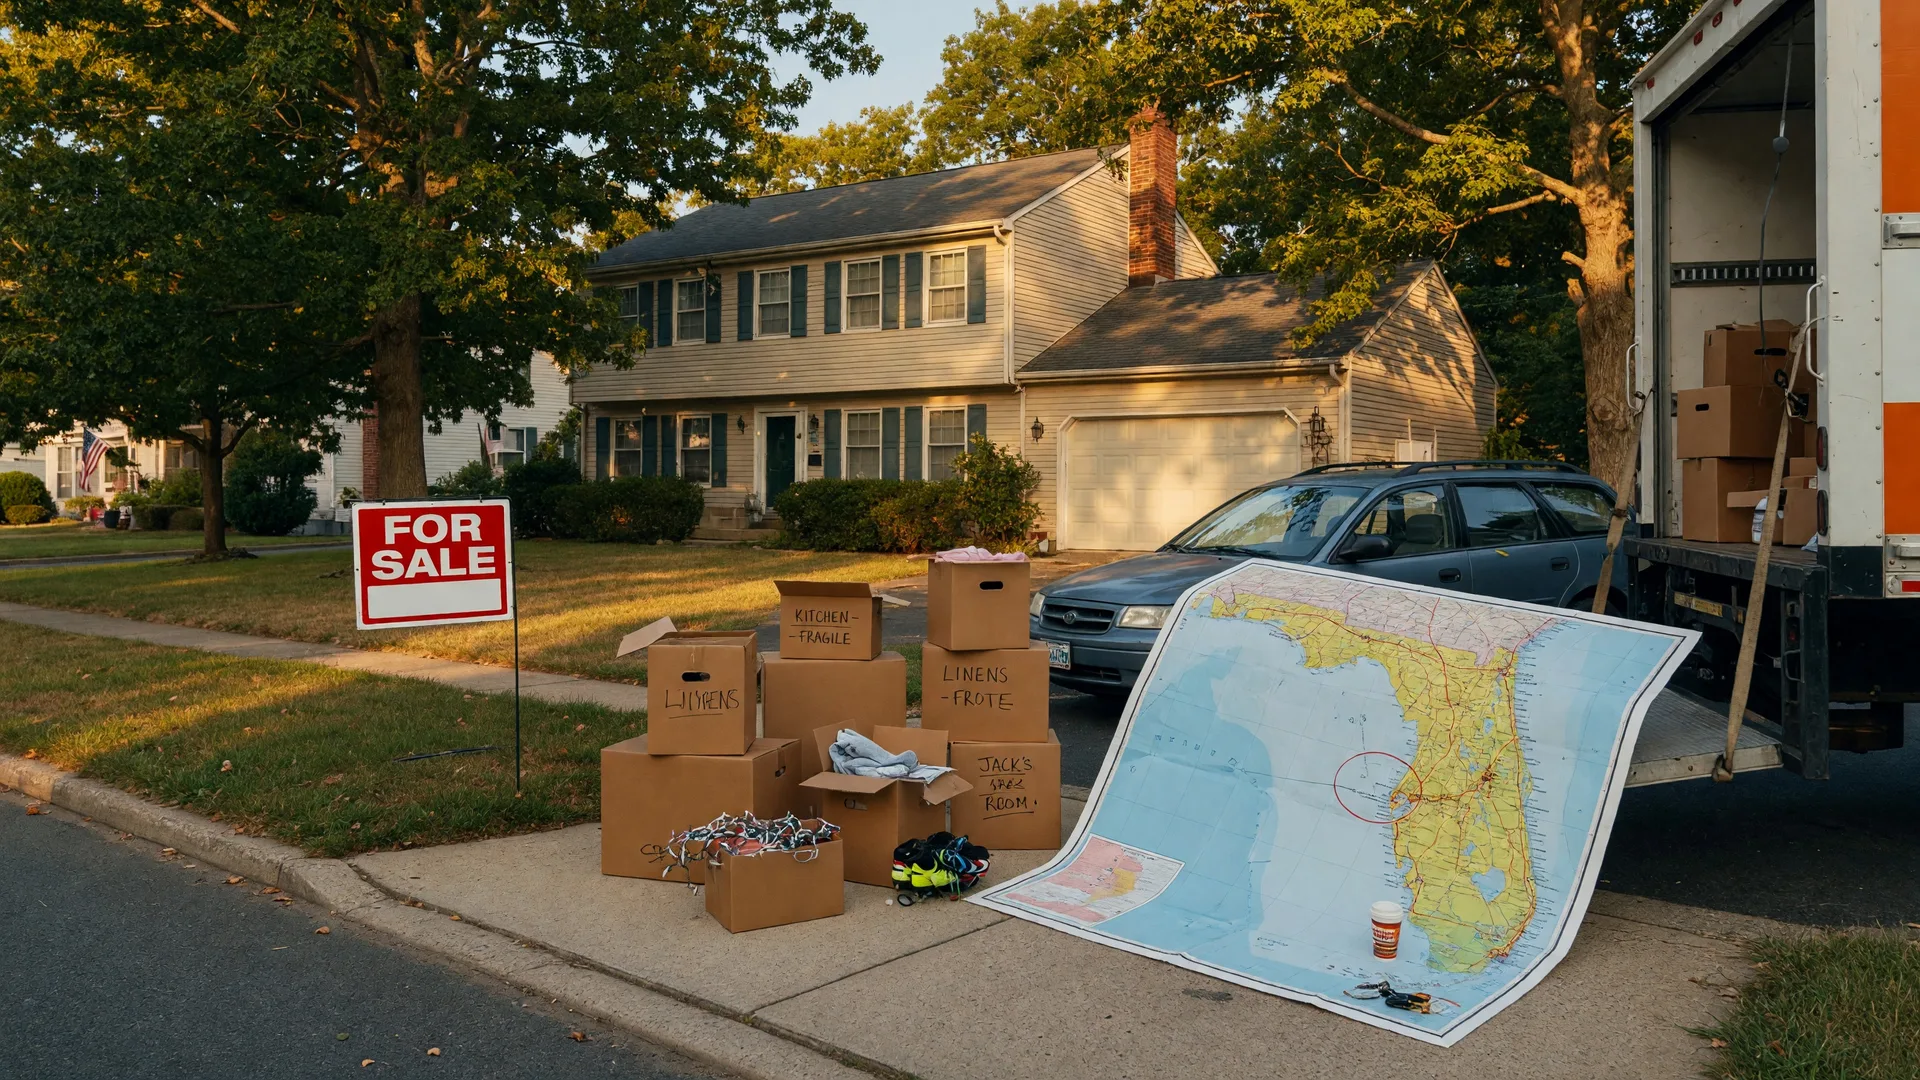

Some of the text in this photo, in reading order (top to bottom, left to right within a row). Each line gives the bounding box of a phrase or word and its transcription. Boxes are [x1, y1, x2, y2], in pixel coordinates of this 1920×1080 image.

[384, 513, 483, 545] FOR
[371, 546, 496, 580] SALE
[943, 665, 1008, 683] LINENS
[978, 756, 1033, 772] JACK'S
